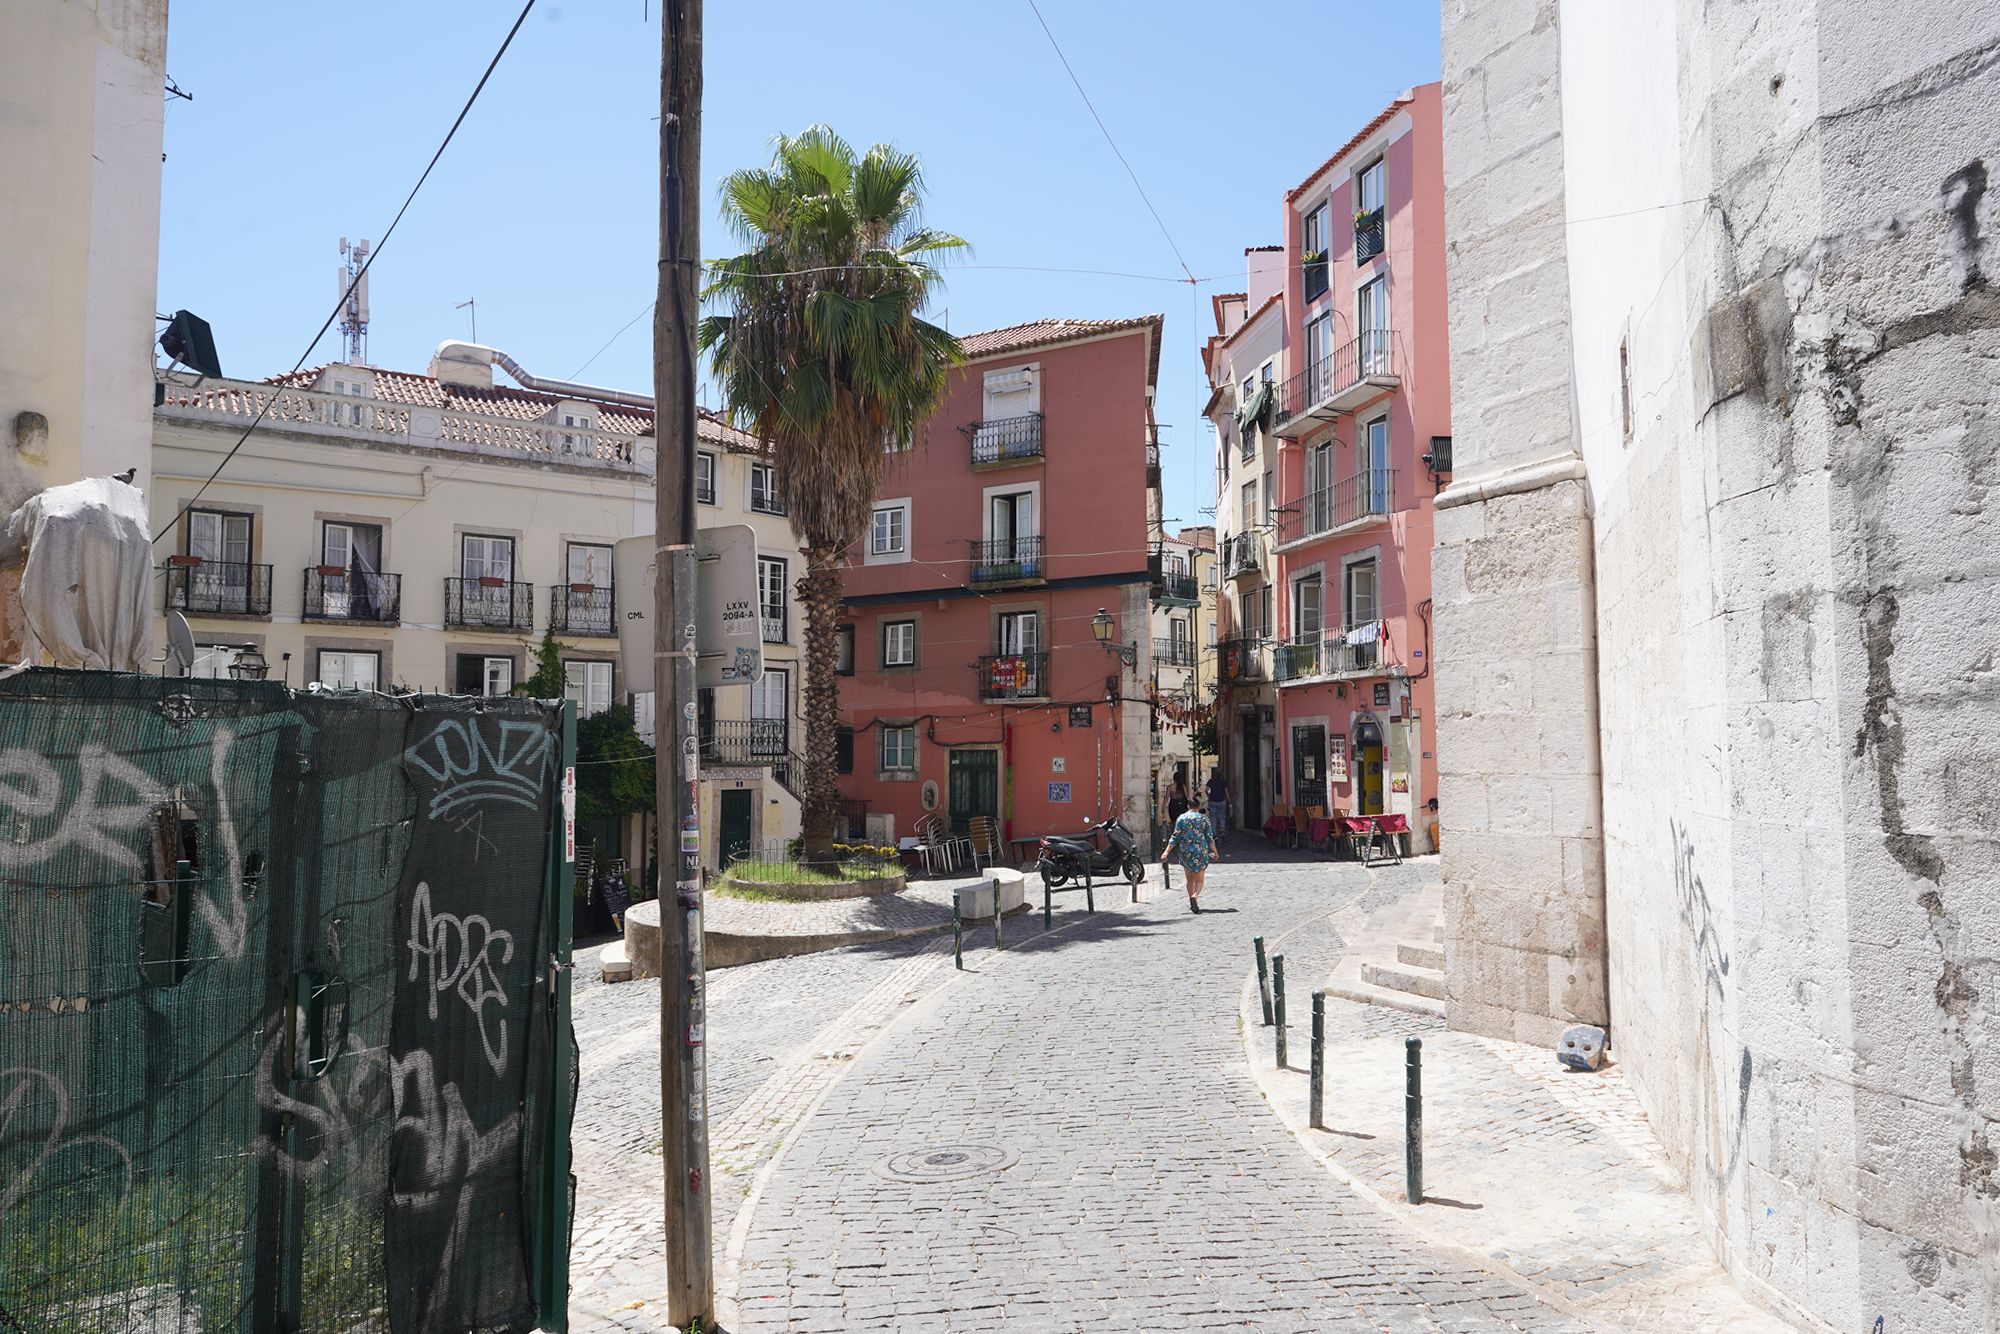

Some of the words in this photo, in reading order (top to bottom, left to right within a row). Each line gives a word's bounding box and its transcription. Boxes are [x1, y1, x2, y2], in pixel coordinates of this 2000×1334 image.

[726, 601, 749, 611] LXXV
[627, 611, 645, 620] CML
[723, 610, 755, 621] 2094-A
